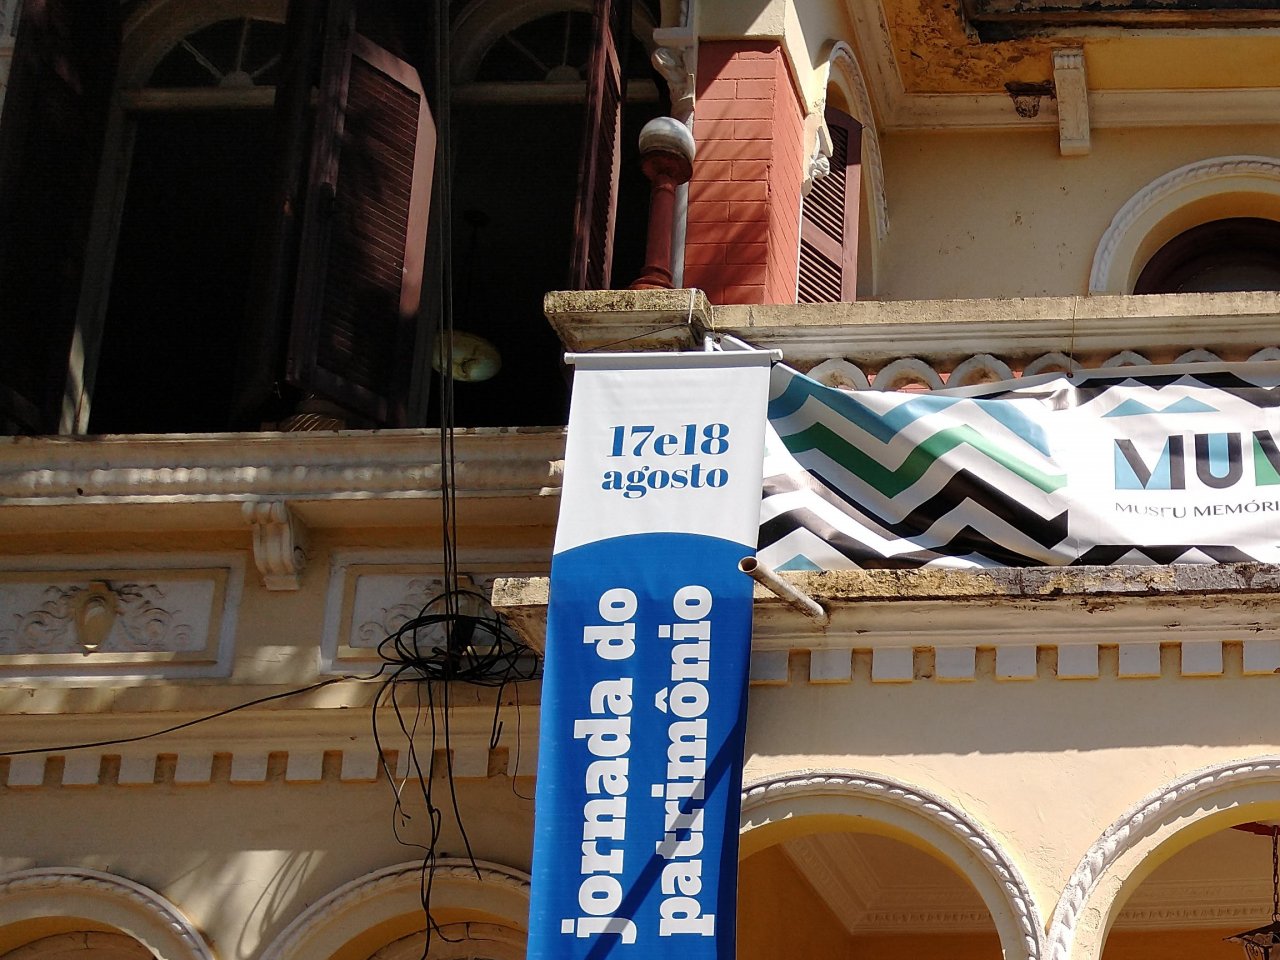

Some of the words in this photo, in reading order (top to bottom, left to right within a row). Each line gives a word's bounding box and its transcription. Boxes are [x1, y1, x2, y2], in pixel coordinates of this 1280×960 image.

[606, 422, 730, 458] 17e18
[601, 462, 729, 499] agosto
[583, 587, 638, 660] do
[651, 584, 715, 938] patrimônio
[561, 676, 637, 945] jornada
